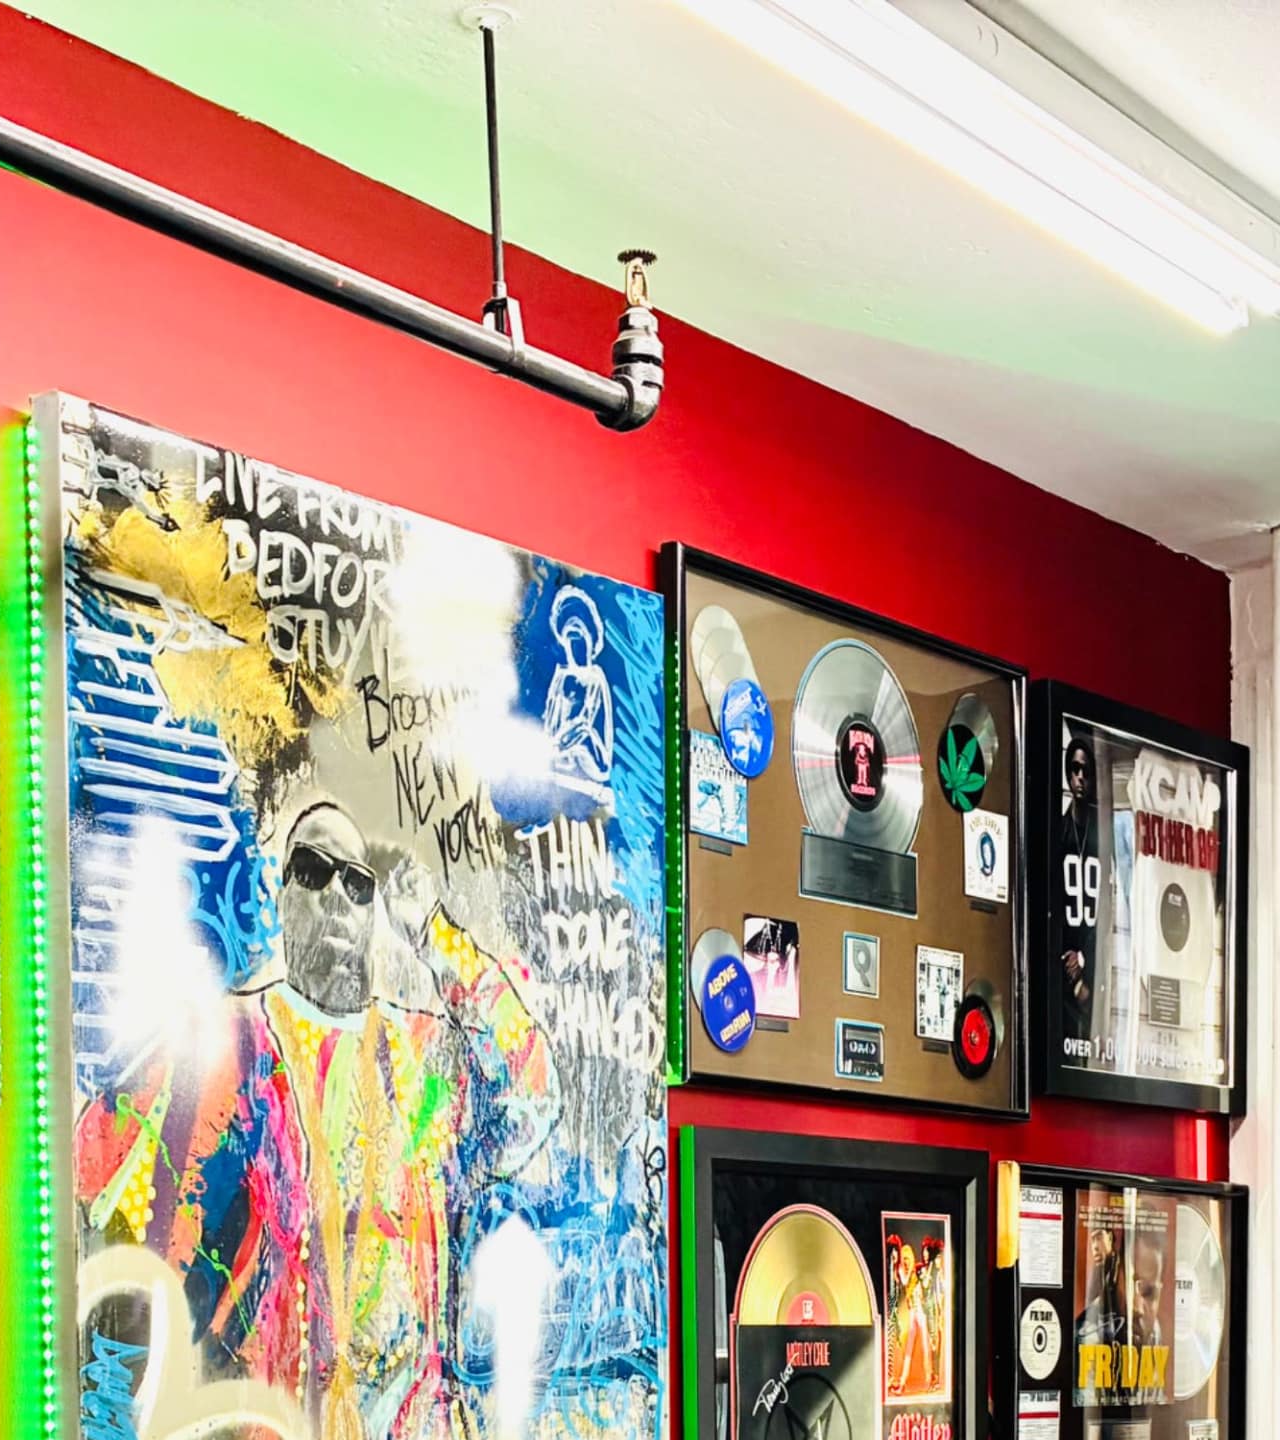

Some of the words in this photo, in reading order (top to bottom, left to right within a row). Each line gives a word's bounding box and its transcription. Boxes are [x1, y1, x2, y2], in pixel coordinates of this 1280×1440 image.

[196, 448, 284, 519] LIVE
[292, 482, 396, 564] FROM
[222, 518, 394, 616] BEDFOR
[1063, 854, 1102, 928] 99
[542, 908, 633, 979] DONE
[1063, 1037, 1091, 1058] OVER
